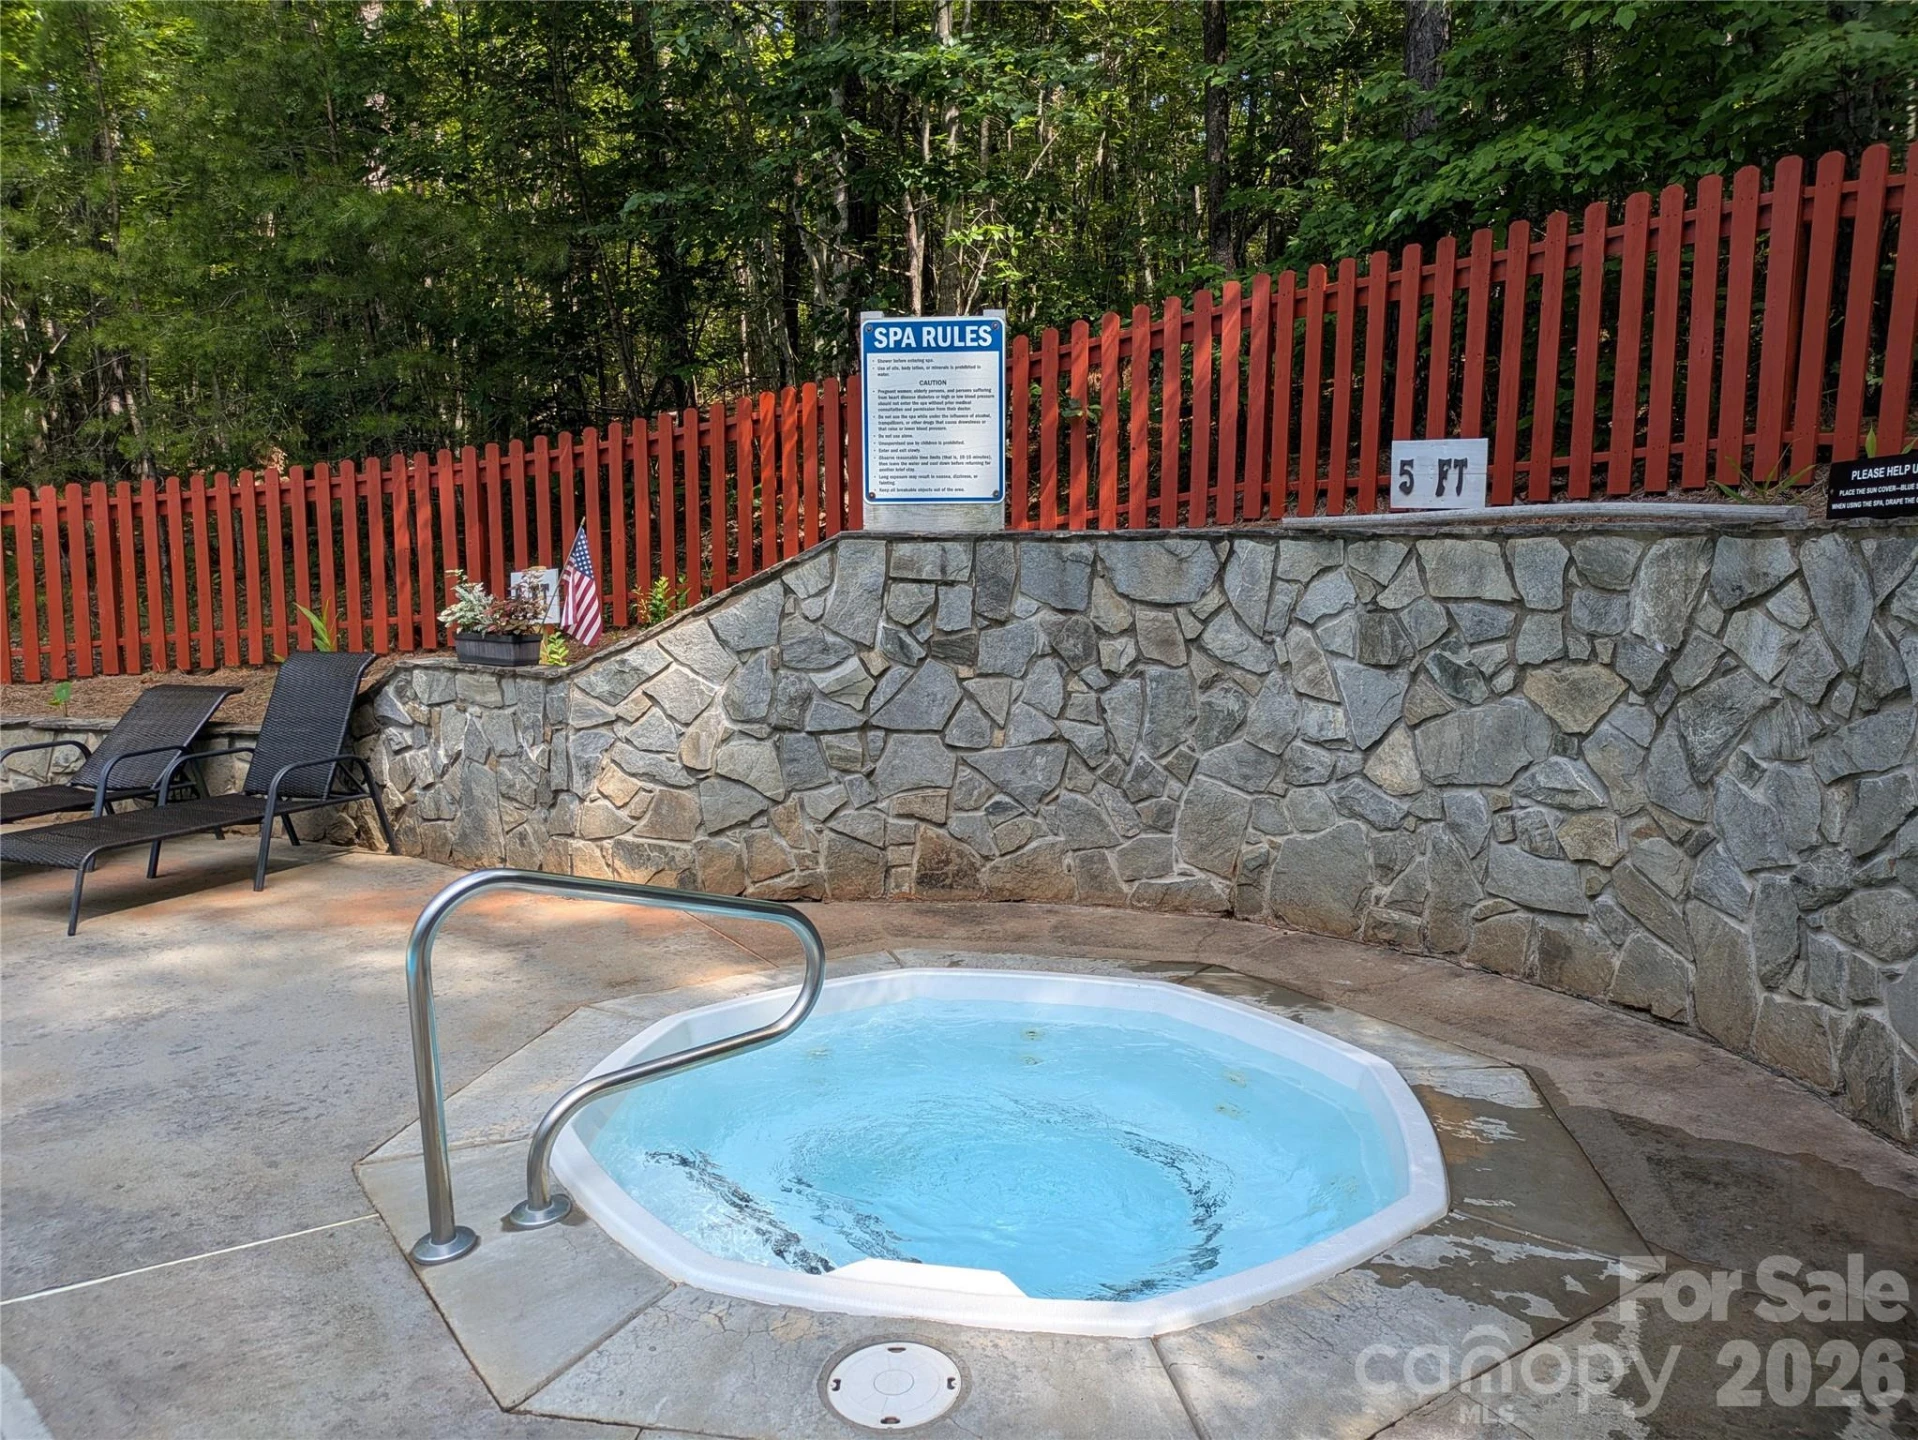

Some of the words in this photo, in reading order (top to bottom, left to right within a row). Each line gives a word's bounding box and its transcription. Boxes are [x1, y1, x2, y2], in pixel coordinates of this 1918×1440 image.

[874, 327, 916, 348] SPA
[922, 325, 992, 347] RULES
[1399, 459, 1414, 496] 5
[1435, 458, 1468, 497] FT
[1851, 467, 1884, 480] PLEASE
[1886, 464, 1910, 477] HELP
